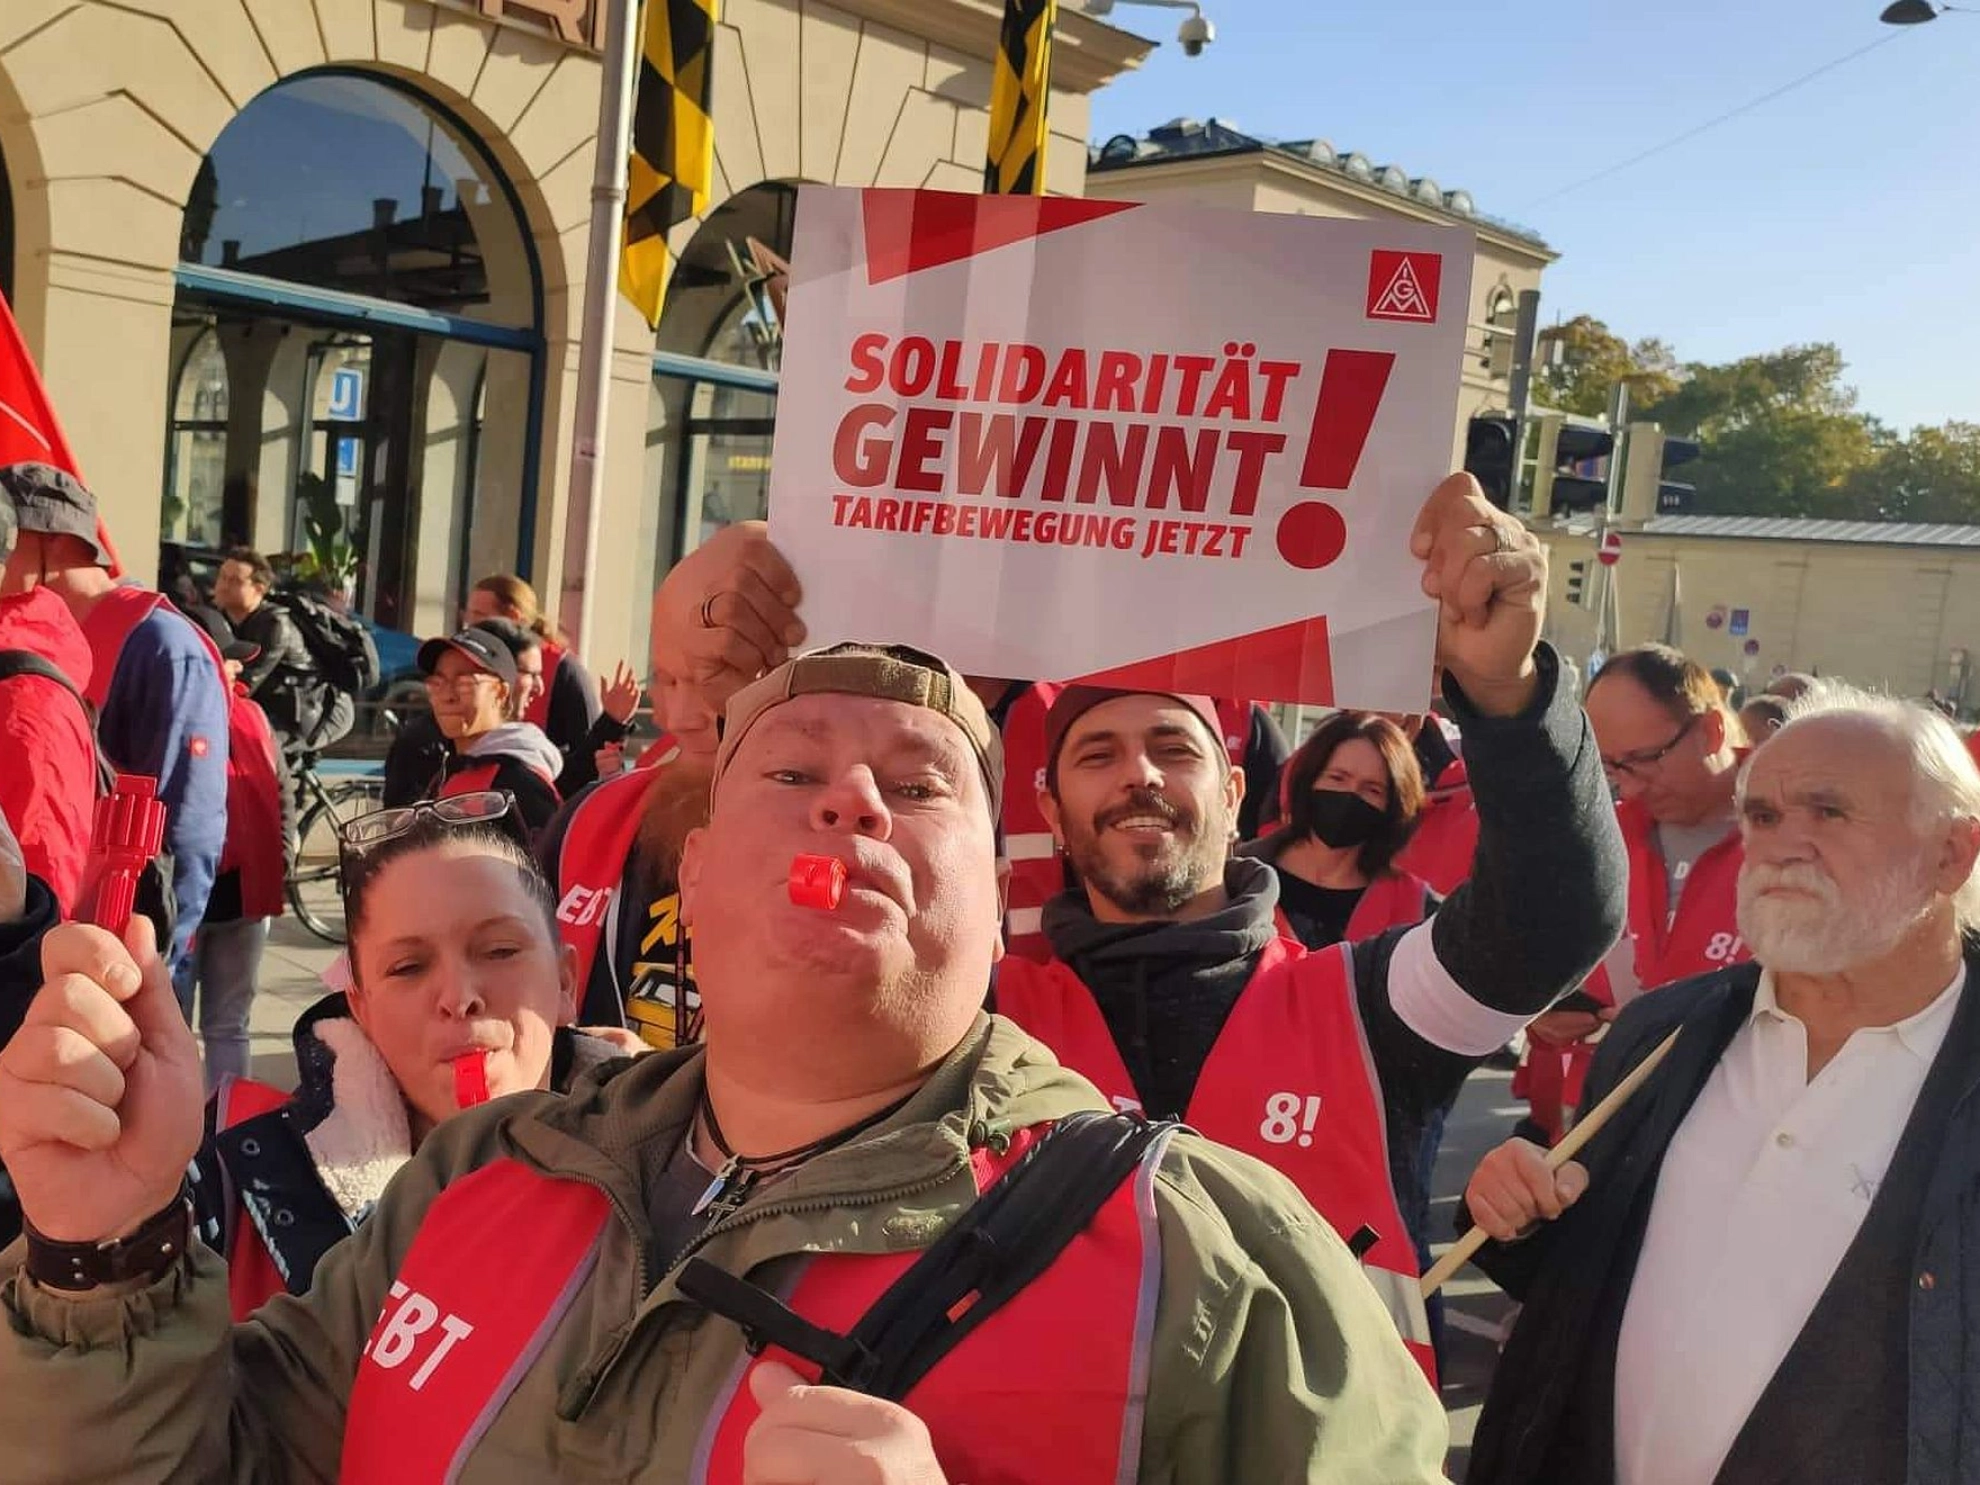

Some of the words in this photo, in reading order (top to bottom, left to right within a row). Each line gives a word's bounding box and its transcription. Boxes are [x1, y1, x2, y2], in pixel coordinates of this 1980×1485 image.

[843, 332, 1302, 424] SOLIDARITÄT
[832, 402, 1288, 517] GEWINNT
[832, 493, 1137, 551] TARIFBEWEGUNG
[1140, 517, 1253, 560] JETZT
[1705, 932, 1742, 964] 8!
[1260, 1092, 1321, 1148] 8!
